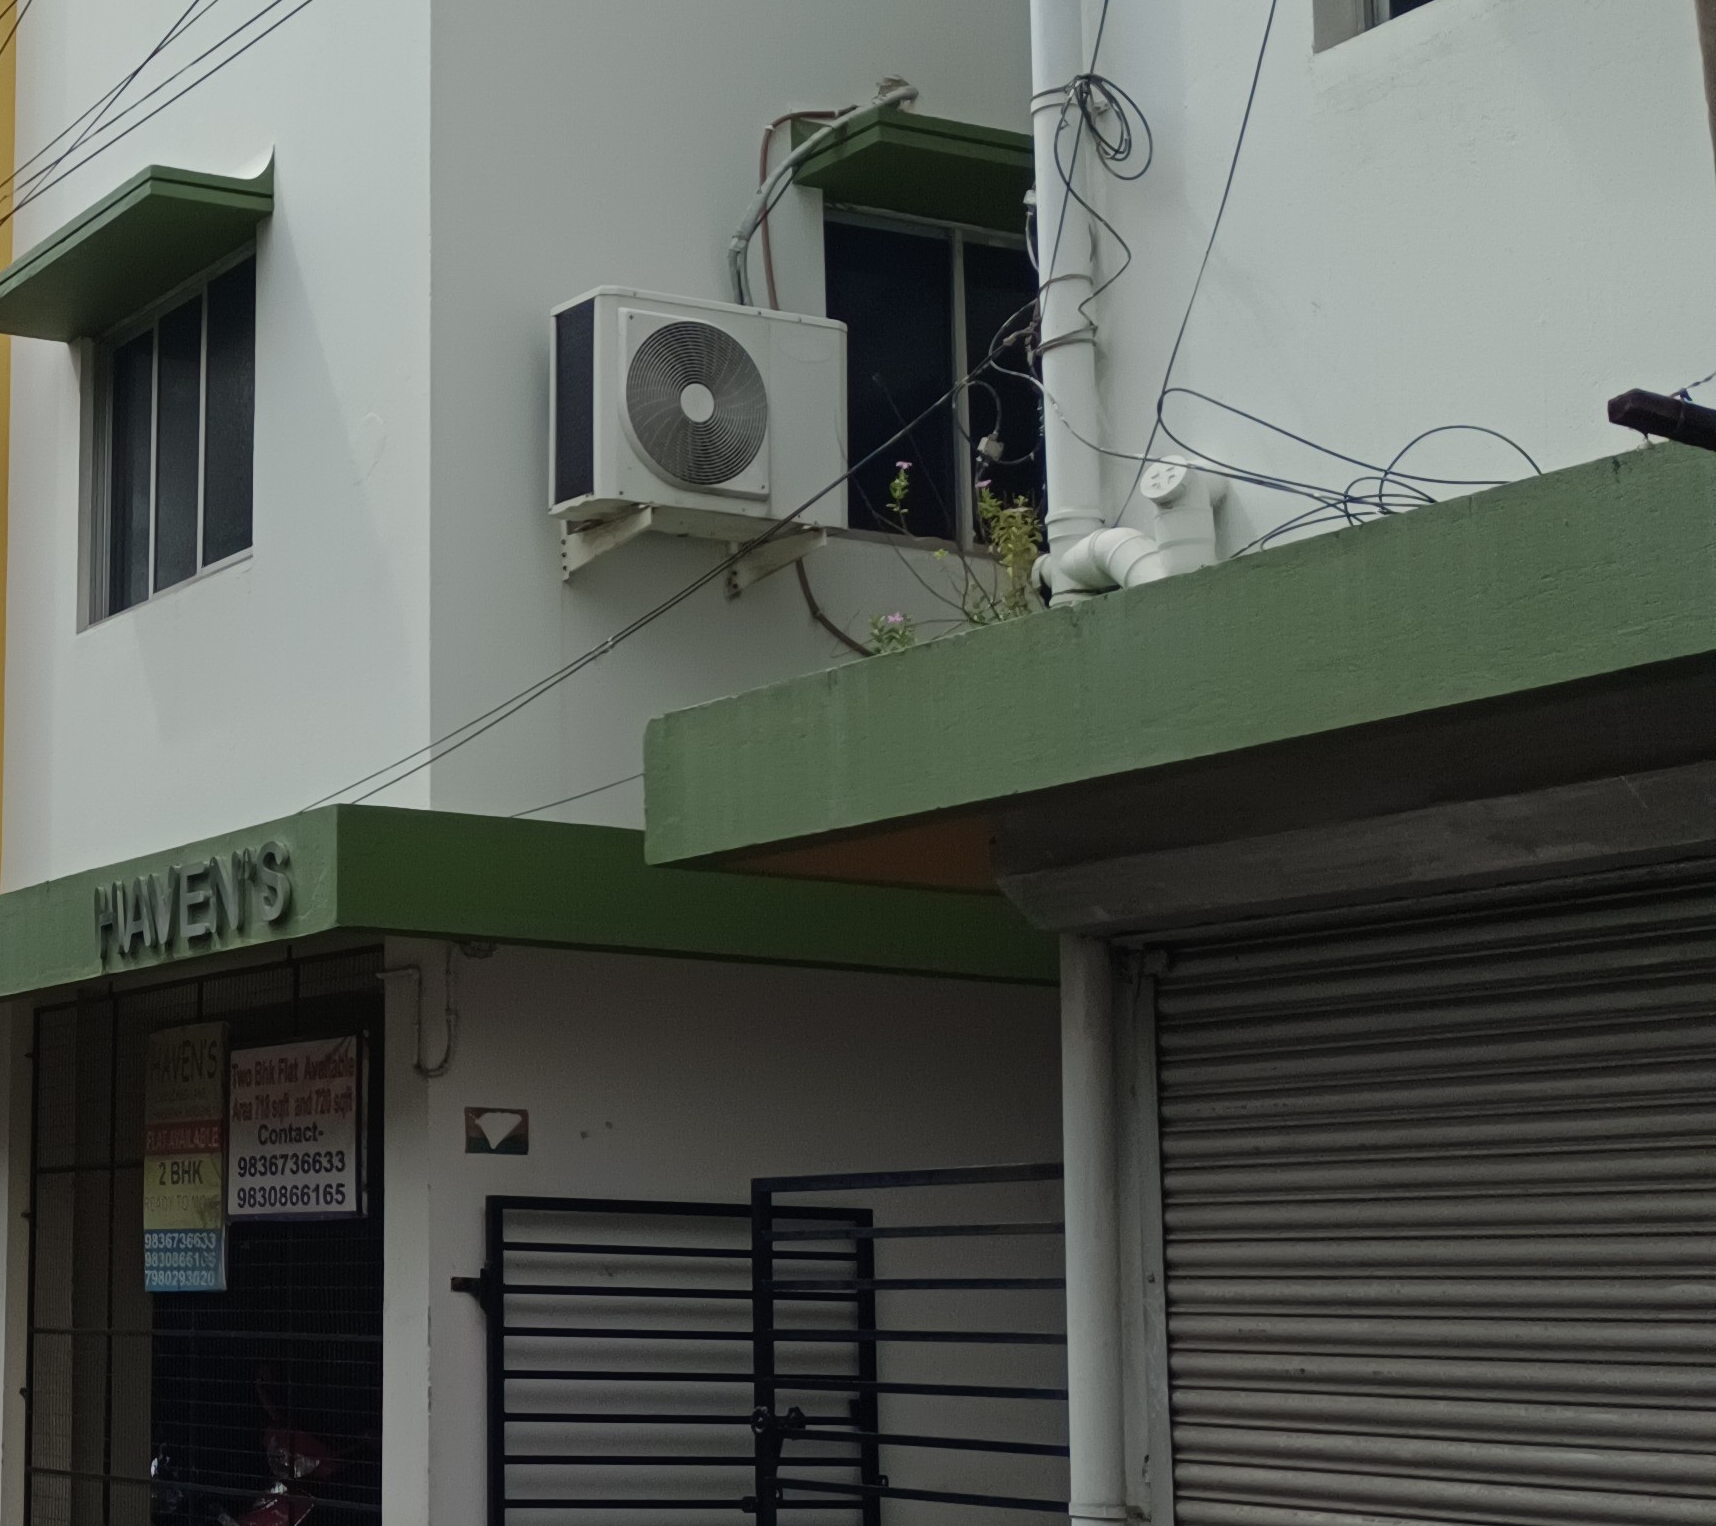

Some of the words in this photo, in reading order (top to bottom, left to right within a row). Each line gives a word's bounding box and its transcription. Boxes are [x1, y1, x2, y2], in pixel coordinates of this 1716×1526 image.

[94, 841, 291, 958] HAVEN'S
[258, 1121, 324, 1146] Contact-
[159, 1162, 167, 1185] 2
[171, 1160, 204, 1185] BHK
[238, 1150, 346, 1177] 9836736633
[237, 1183, 346, 1208] 9830866165
[145, 1232, 216, 1249] 9836736633
